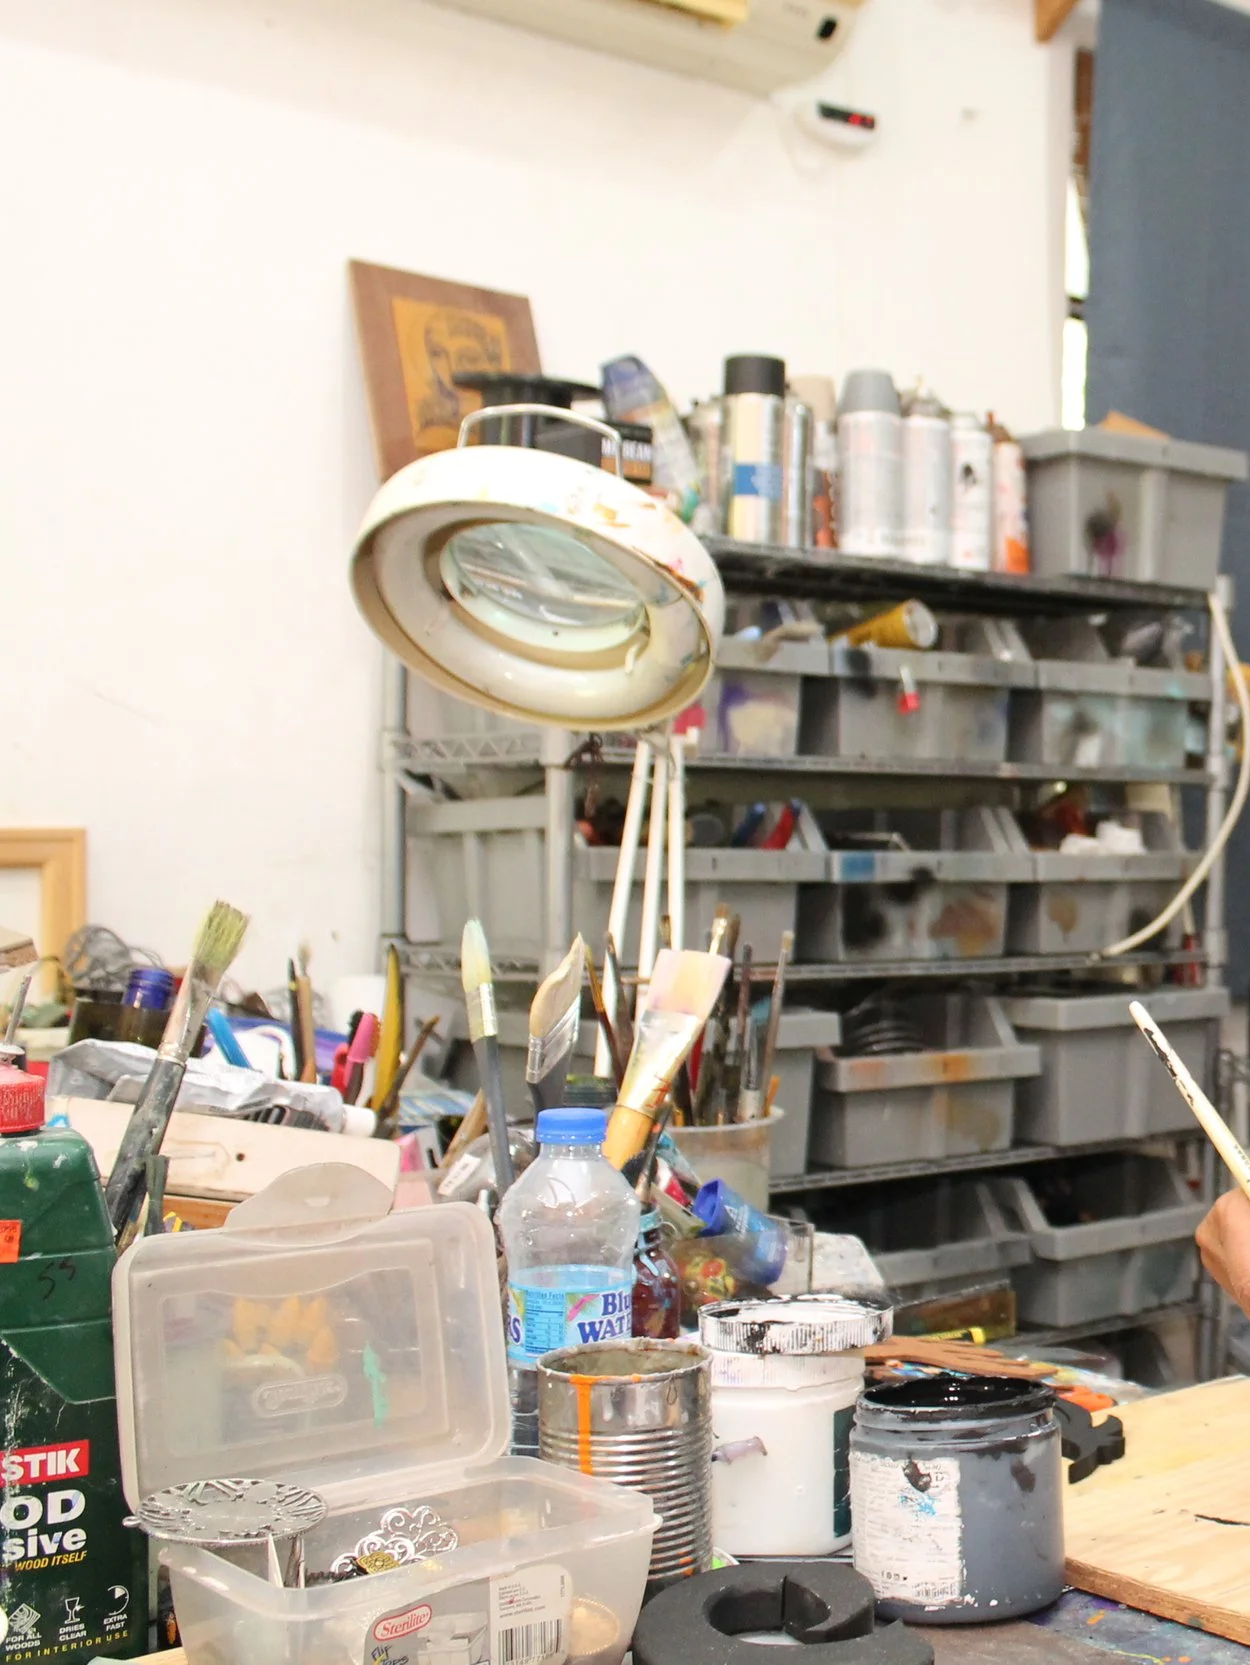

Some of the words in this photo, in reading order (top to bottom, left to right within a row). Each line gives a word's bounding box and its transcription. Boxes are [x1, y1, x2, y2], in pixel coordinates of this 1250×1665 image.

[15, 1557, 49, 1571] WOOD
[51, 1550, 87, 1566] ITSELF
[103, 1613, 128, 1625] EXTRA
[382, 1612, 426, 1637] Sterilite
[59, 1623, 85, 1634] DRIES
[106, 1621, 125, 1632] FAST
[5, 1635, 25, 1644] FOR
[26, 1631, 42, 1640] ALL
[59, 1630, 87, 1642] CLEAR
[5, 1639, 41, 1652] WOODS
[5, 1651, 32, 1662] FOR
[37, 1636, 102, 1657] INTERIOR
[106, 1630, 128, 1643] USE
